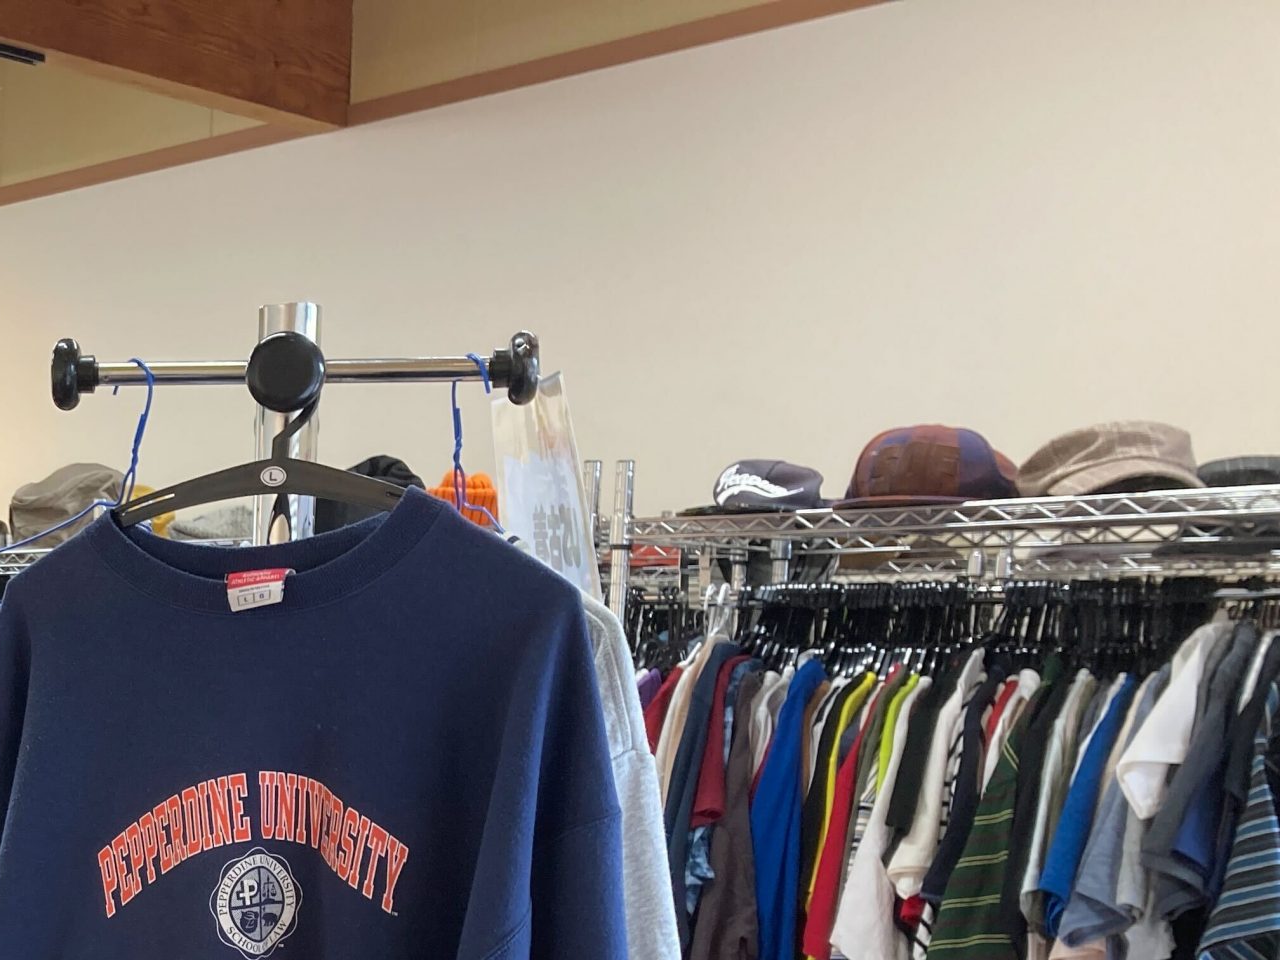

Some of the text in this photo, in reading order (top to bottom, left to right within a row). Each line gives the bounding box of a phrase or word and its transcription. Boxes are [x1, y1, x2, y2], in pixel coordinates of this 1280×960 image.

[269, 471, 278, 482] L
[98, 770, 409, 918] PEPPERDINE UNIVERSITY
[218, 854, 295, 916] PEPPERDINE UNIVERSITY
[226, 926, 261, 954] SCHOOL
[268, 920, 288, 944] LAW
